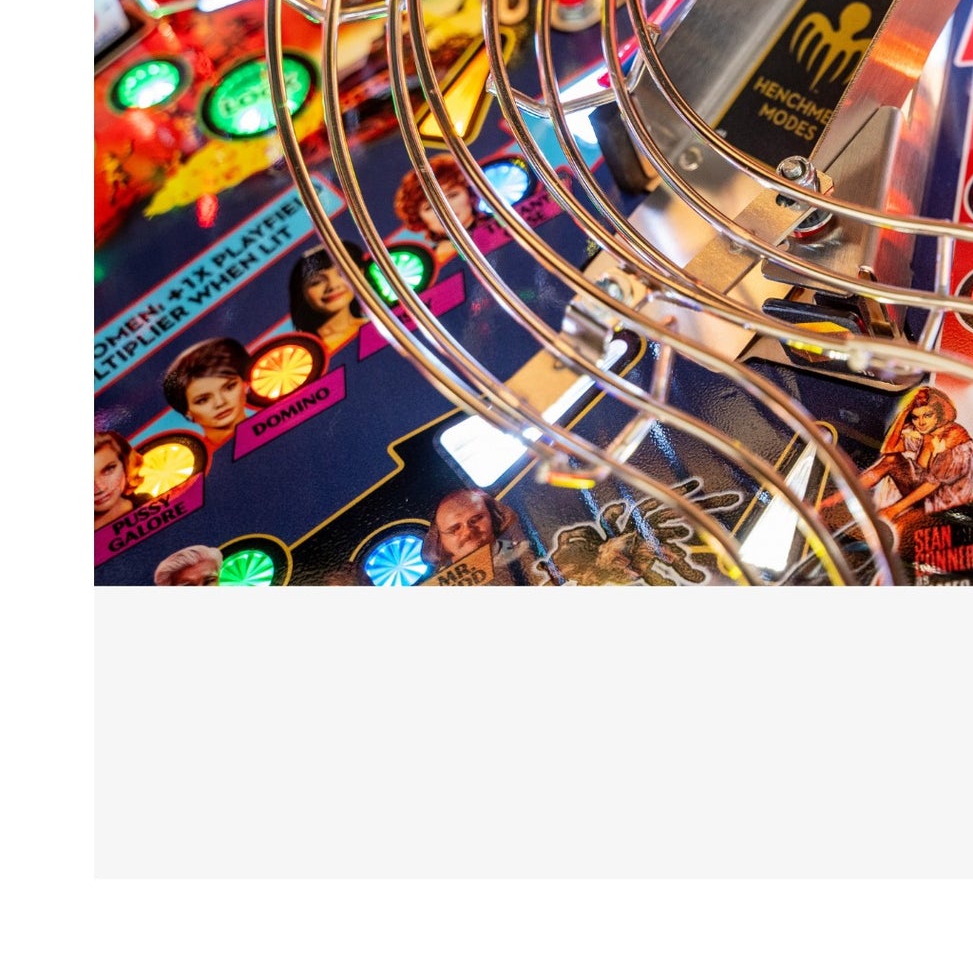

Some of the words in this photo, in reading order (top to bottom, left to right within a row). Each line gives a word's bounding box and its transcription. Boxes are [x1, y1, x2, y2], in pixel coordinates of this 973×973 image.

[753, 75, 834, 125] HENCHME
[759, 102, 818, 141] MODES
[94, 305, 190, 381] LTIPLIER
[188, 253, 257, 305] WHEN
[258, 225, 293, 255] LIT
[94, 302, 165, 358] OMEN:
[168, 266, 211, 302] +1X
[252, 386, 330, 437] DOMINO
[107, 501, 187, 553] GALORE
[111, 494, 171, 535] PUSSY
[914, 524, 952, 553] SEAN
